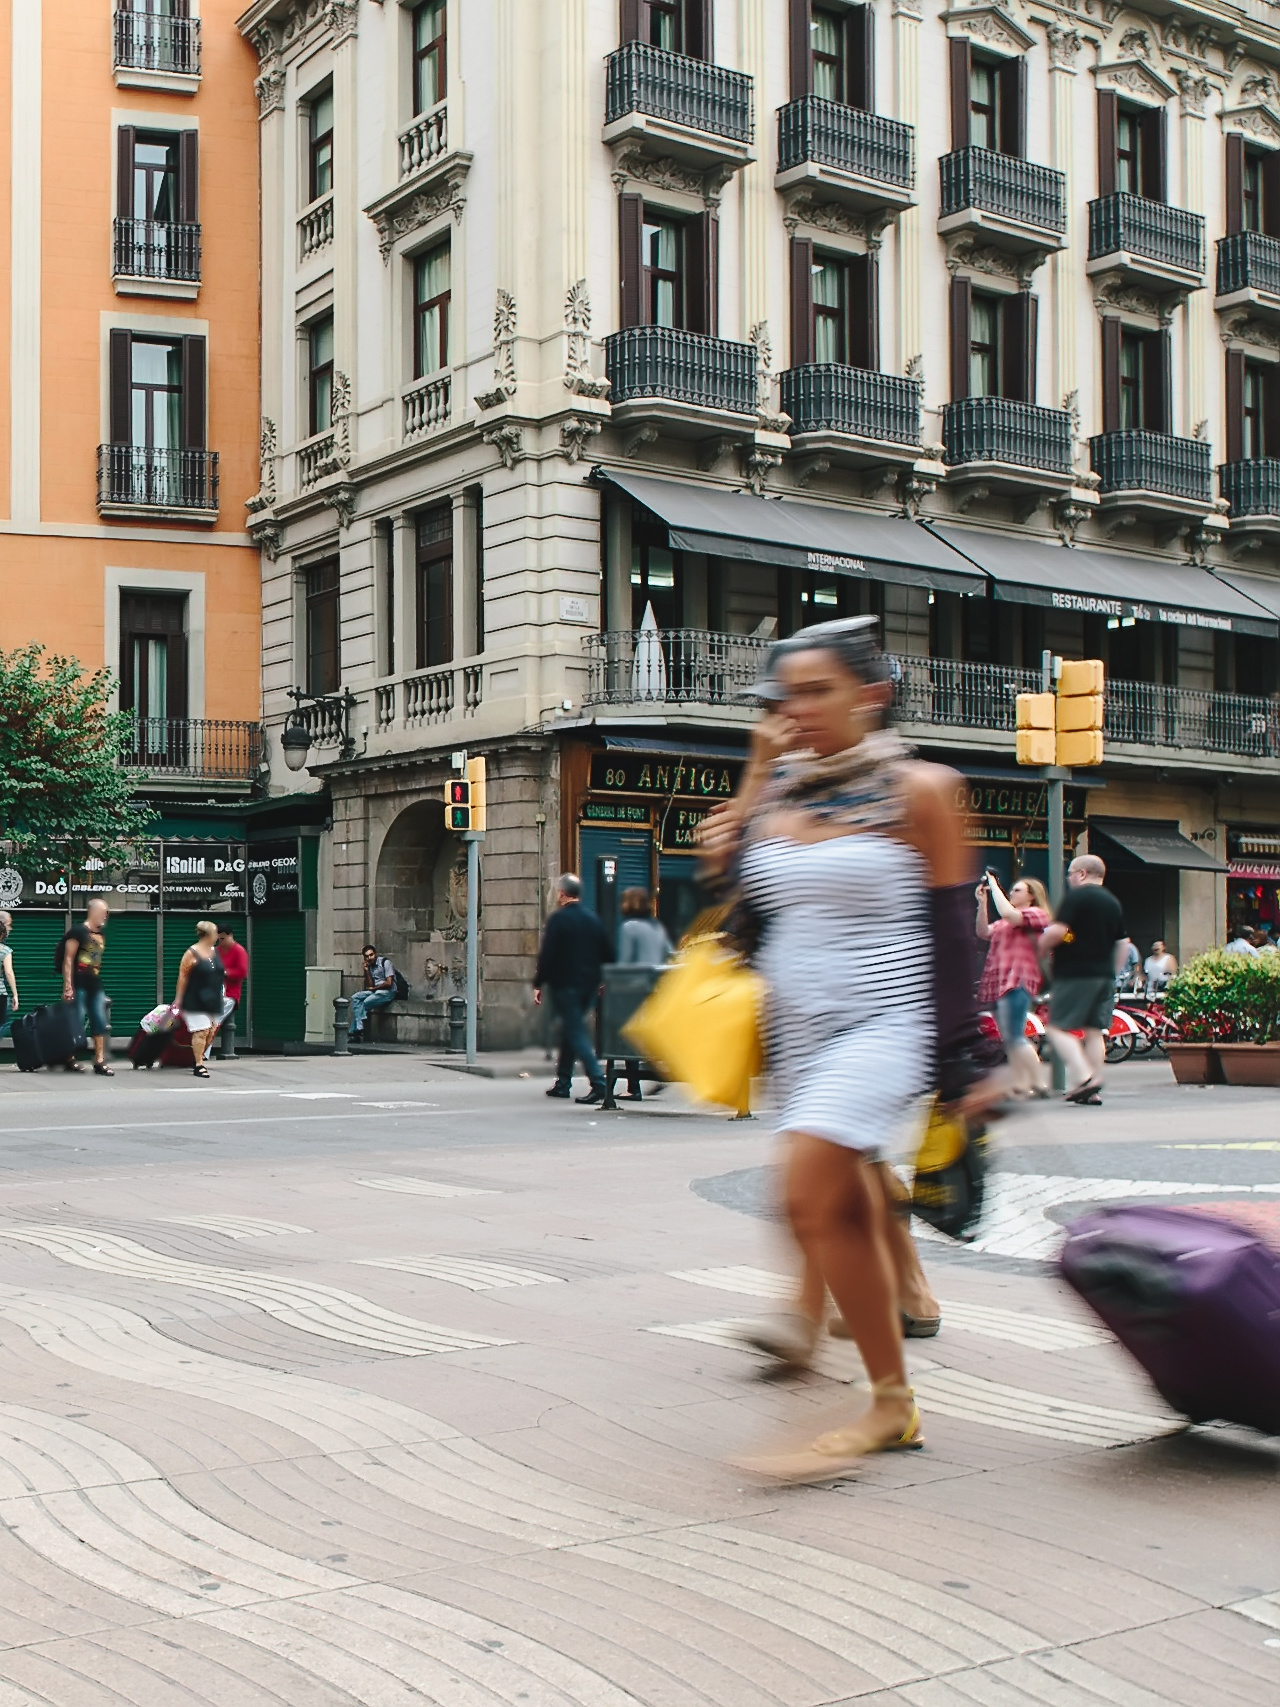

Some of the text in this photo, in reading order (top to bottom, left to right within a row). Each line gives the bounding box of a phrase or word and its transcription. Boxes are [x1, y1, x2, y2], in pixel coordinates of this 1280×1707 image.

[807, 552, 866, 572] INTERNACIONAL
[1052, 593, 1122, 615] RESTAURANTE
[605, 764, 732, 793] 80 ANTIGA
[617, 807, 626, 819] DE
[627, 806, 645, 820] PUNT
[214, 859, 245, 872] D&G
[271, 857, 297, 867] GEOX
[35, 881, 68, 895] D&G
[116, 884, 159, 893] GEOX
